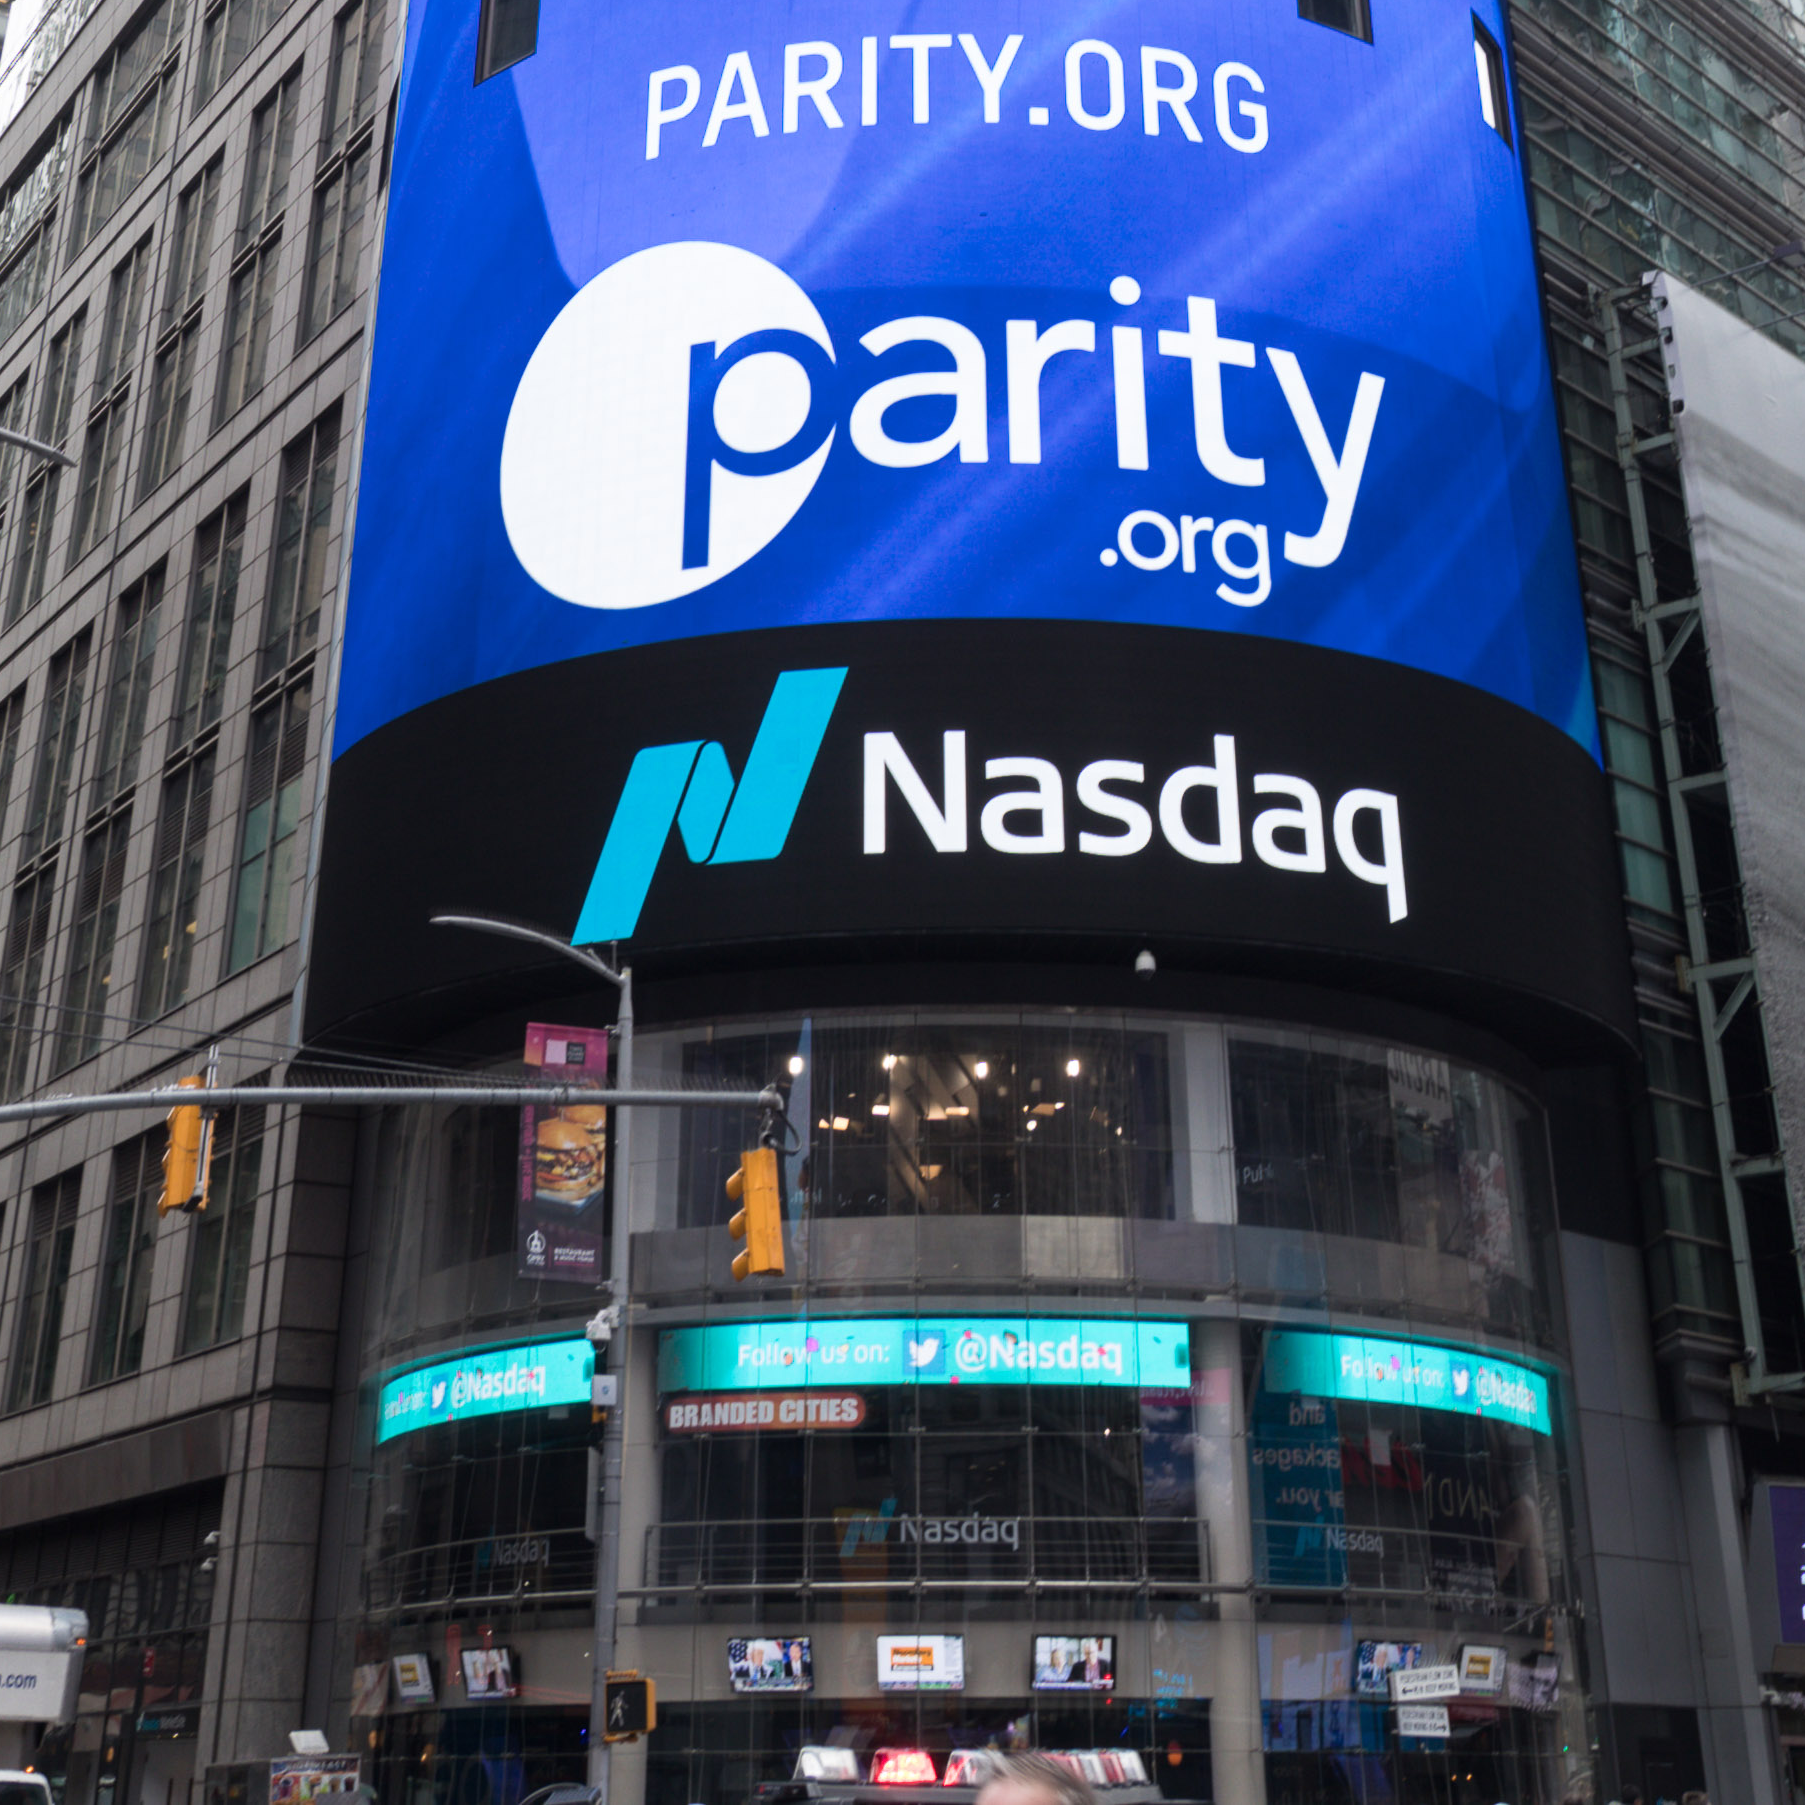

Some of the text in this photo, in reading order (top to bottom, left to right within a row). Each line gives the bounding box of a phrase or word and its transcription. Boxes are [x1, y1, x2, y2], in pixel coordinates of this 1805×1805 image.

[644, 33, 1270, 161] PARITY.ORG
[681, 275, 1387, 571] parity
[1099, 508, 1272, 608] .org
[863, 729, 1409, 923] Nasdaq
[738, 1333, 1123, 1376] Follow us on: @Nasdaq
[1341, 1355, 1395, 1382] Follow
[1403, 1366, 1419, 1384] us
[451, 1362, 546, 1409] @Nasdaq
[669, 1398, 858, 1429] BRANDED CITIES
[899, 1513, 1021, 1552] Nasdaq
